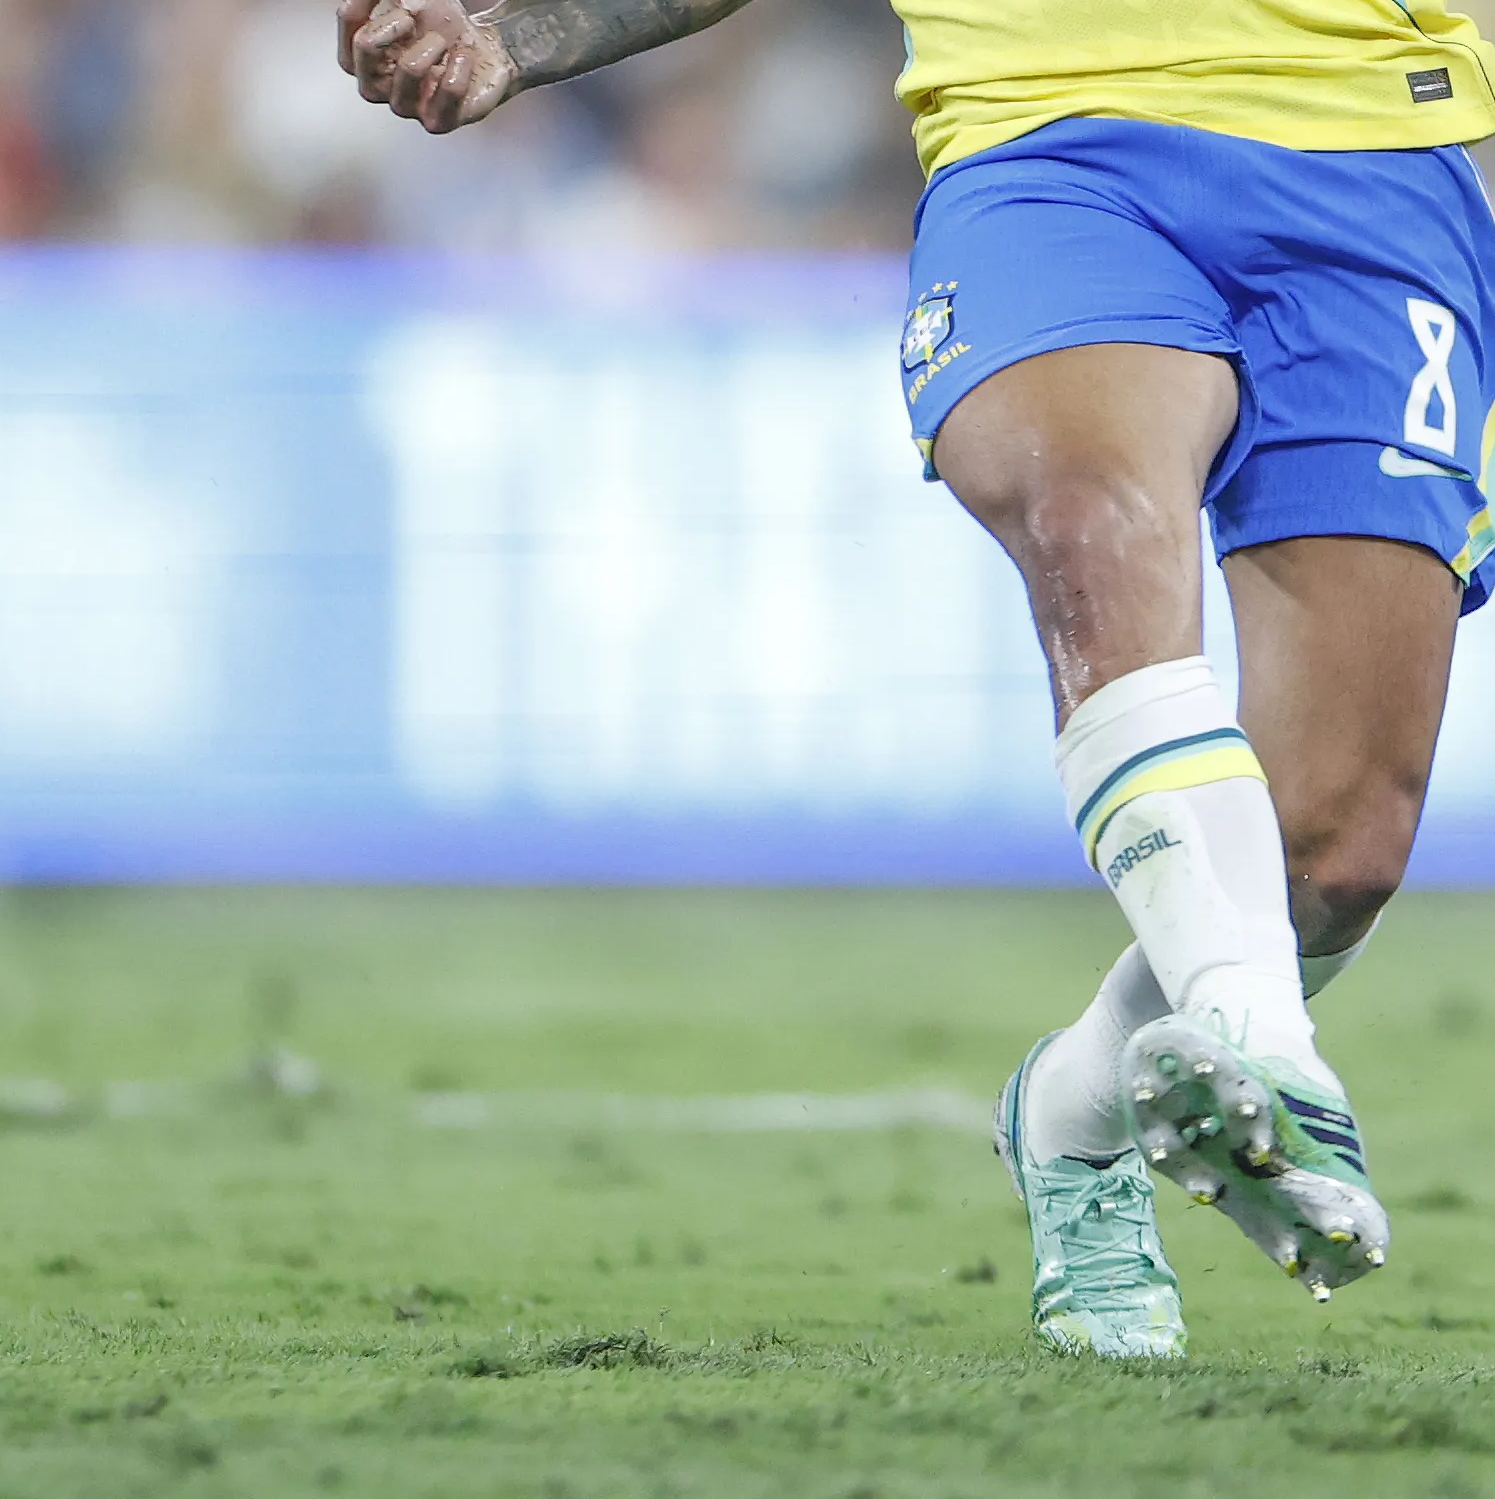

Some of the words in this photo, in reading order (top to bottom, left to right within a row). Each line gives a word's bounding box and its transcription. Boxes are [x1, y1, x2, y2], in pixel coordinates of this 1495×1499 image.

[908, 342, 972, 405] BRASIL
[1404, 297, 1457, 459] 8
[1107, 828, 1183, 889] BRASIL
